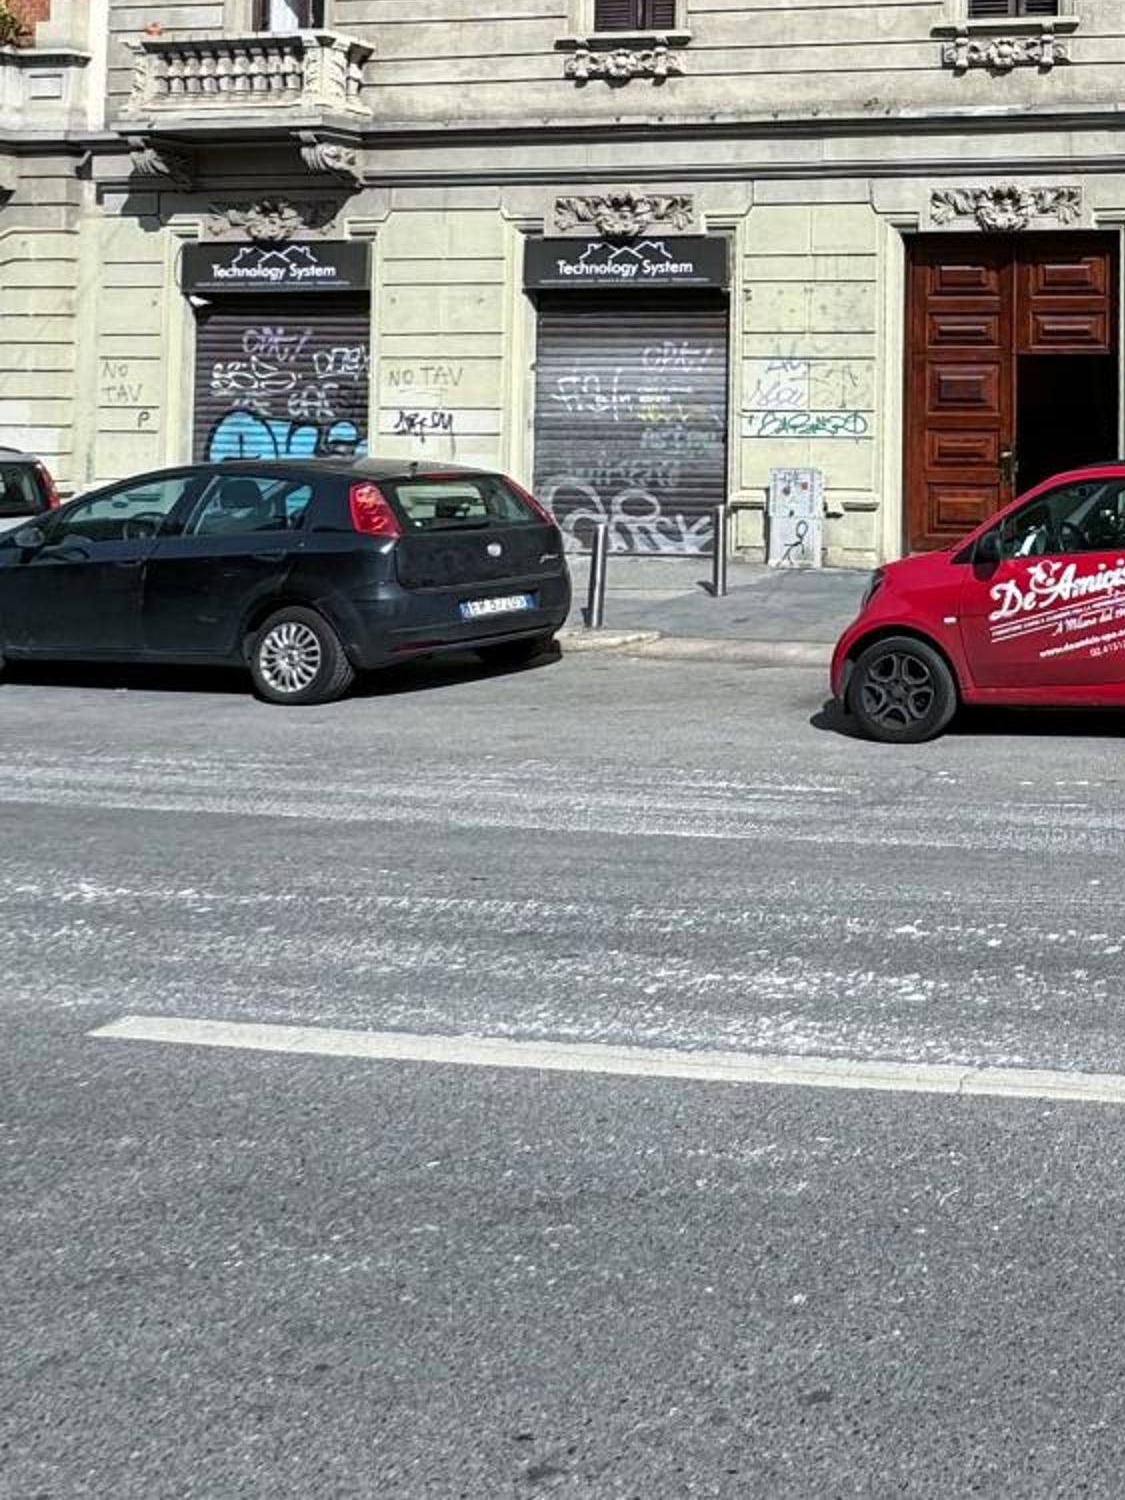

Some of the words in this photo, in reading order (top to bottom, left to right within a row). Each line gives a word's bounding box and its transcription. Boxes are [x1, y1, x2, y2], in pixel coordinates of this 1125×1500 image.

[212, 261, 286, 281] Technology
[289, 263, 337, 281] System
[557, 258, 639, 277] Technology
[642, 259, 693, 277] System
[388, 368, 416, 387] NO
[419, 366, 463, 387] TAV
[989, 579, 1037, 621] De
